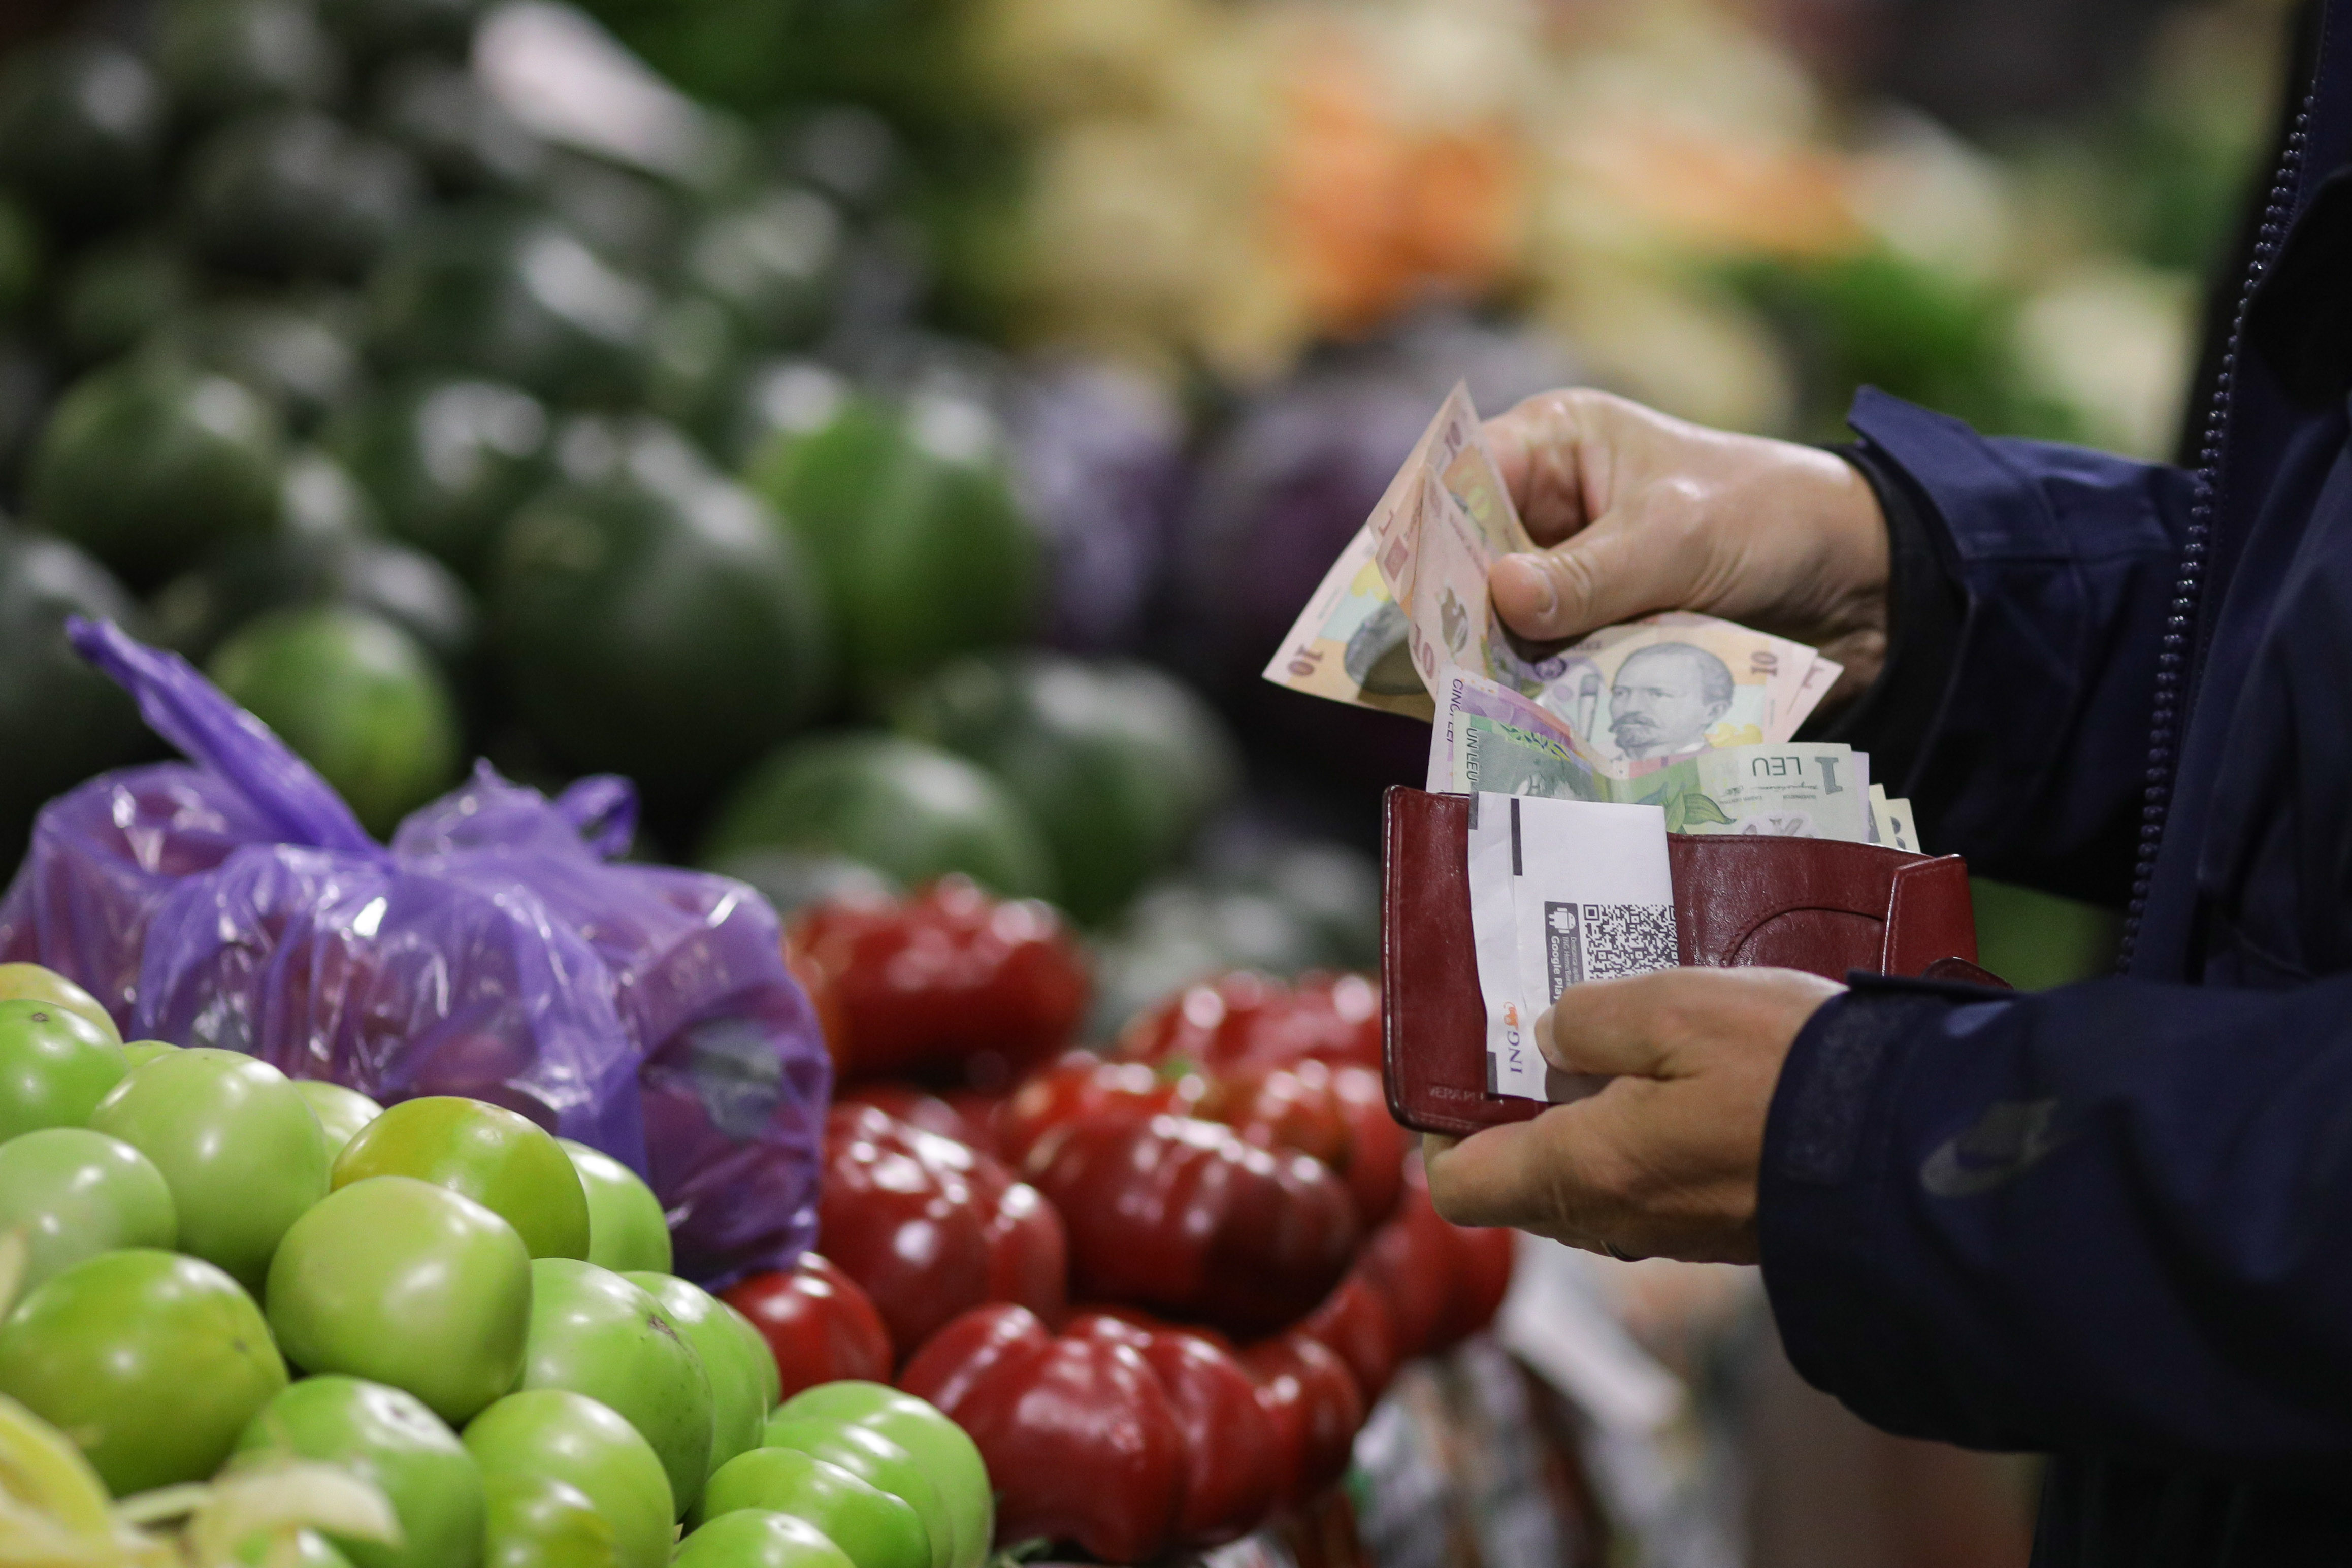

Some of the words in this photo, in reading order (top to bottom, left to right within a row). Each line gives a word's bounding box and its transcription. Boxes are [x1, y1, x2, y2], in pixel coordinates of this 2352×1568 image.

[1287, 644, 1323, 678] 10
[1413, 623, 1435, 679] 10
[1751, 651, 1778, 677] 10
[1466, 727, 1477, 749] UN
[1466, 753, 1478, 781] LEU
[1752, 757, 1801, 776] LEU
[1815, 756, 1843, 795] 1
[1551, 935, 1561, 975] Google
[1553, 977, 1563, 1000] Play
[1507, 1031, 1522, 1074] ING
